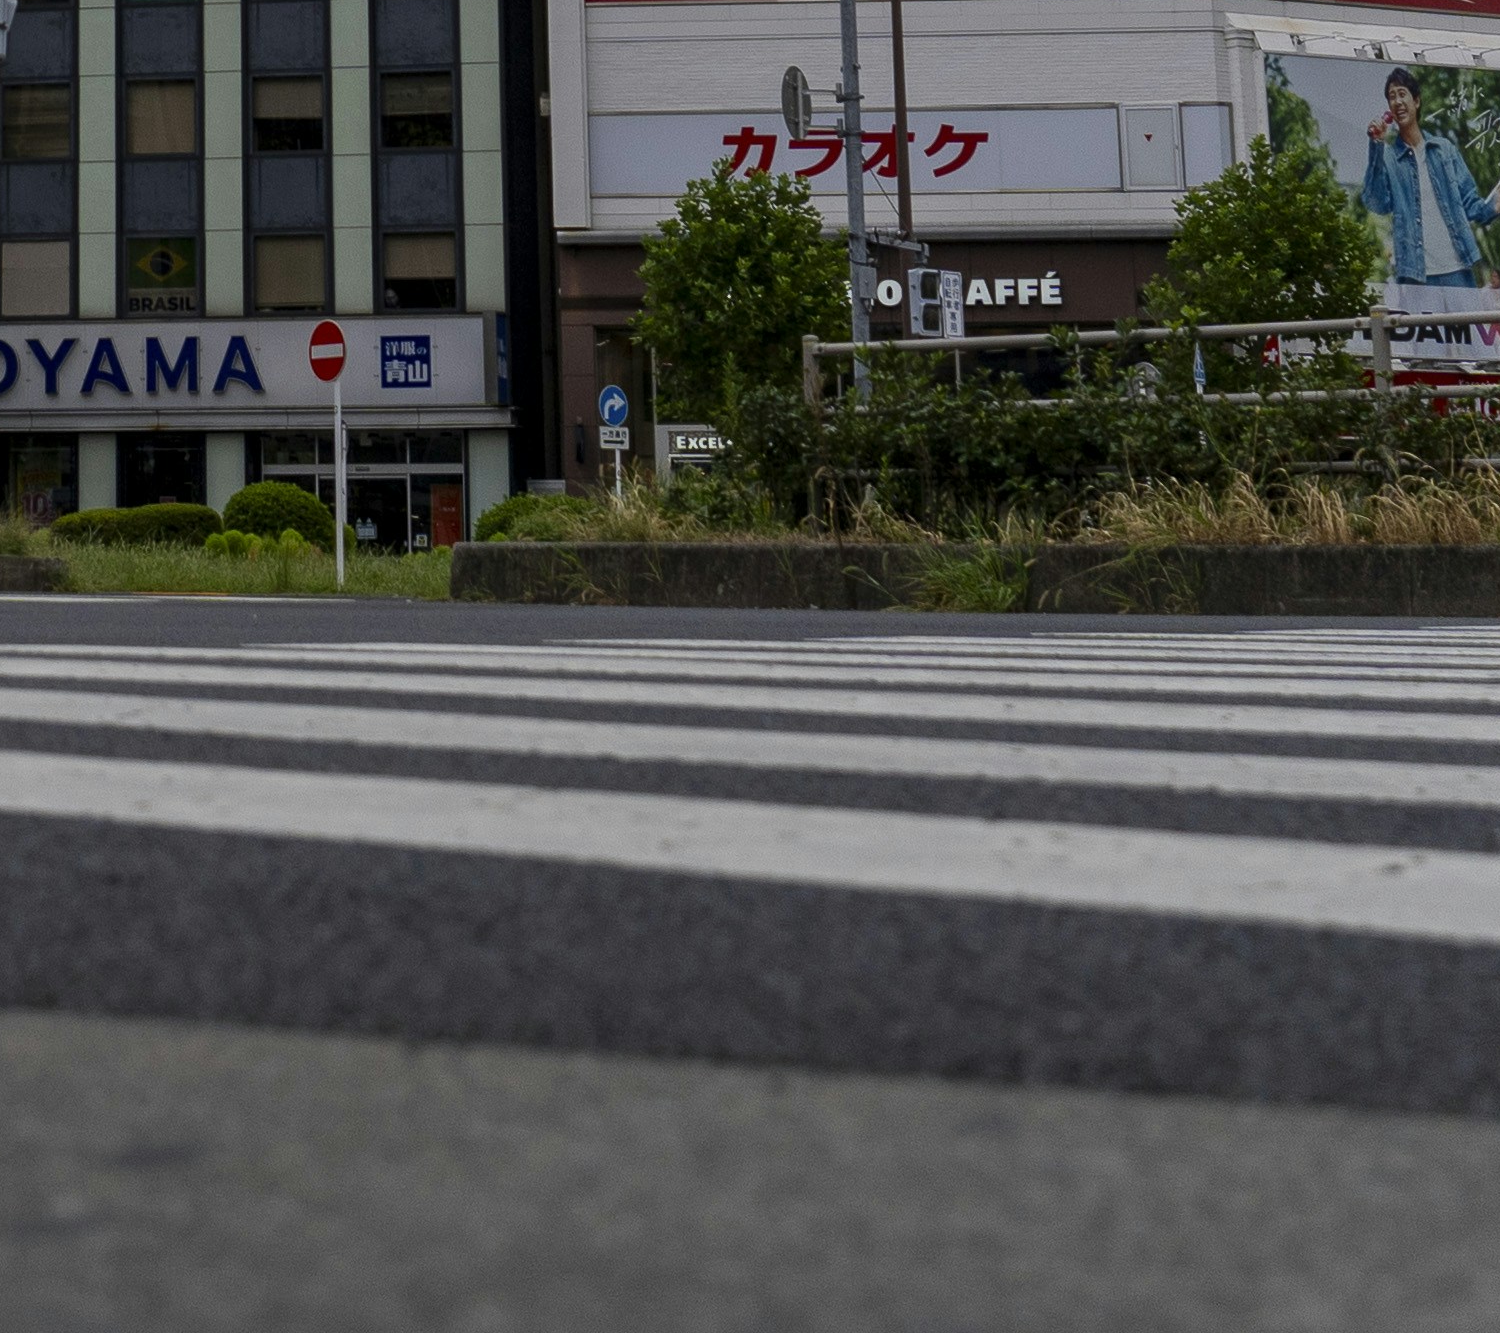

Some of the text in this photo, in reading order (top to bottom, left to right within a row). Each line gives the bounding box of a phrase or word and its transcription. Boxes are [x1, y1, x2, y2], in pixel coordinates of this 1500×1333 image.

[722, 124, 989, 179] カラオケ
[940, 270, 1063, 306] AFFÉ
[129, 296, 197, 312] BRASIL
[385, 340, 427, 356] 洋服の
[384, 359, 428, 383] 青山
